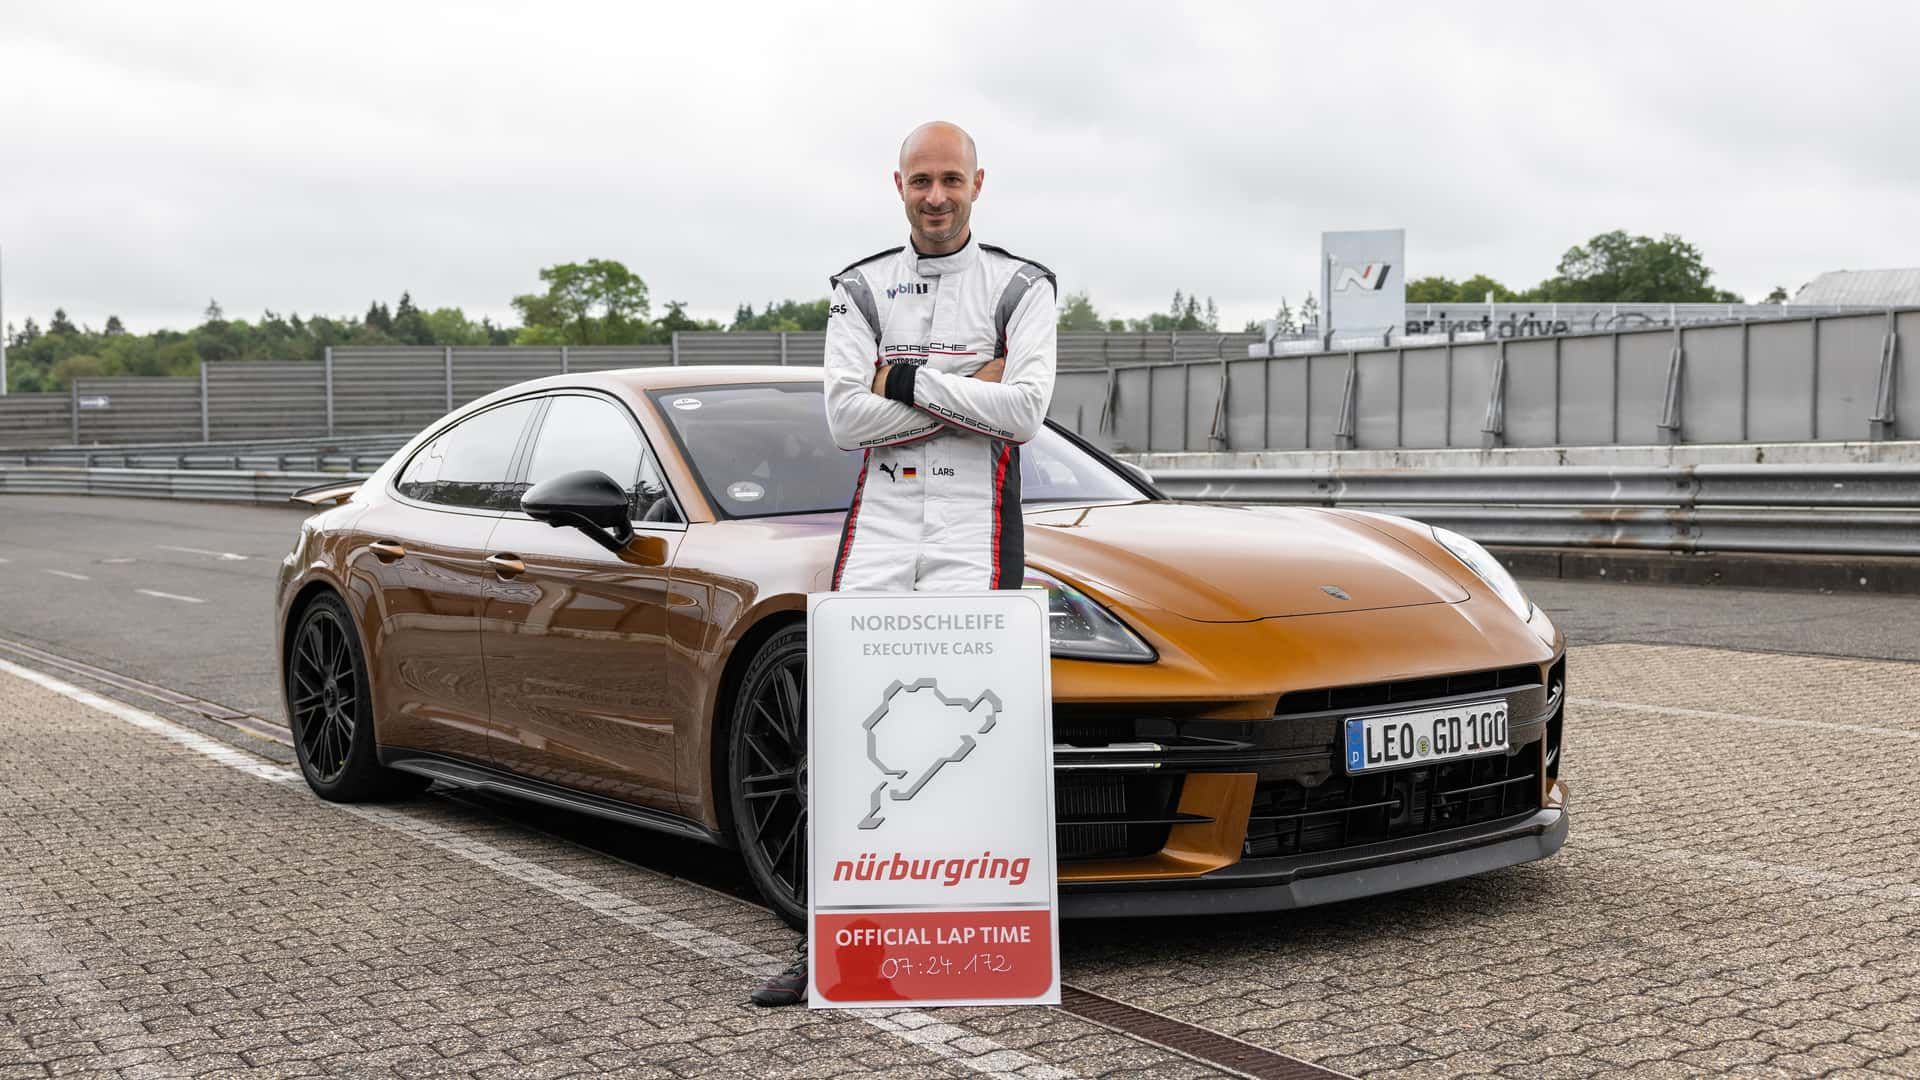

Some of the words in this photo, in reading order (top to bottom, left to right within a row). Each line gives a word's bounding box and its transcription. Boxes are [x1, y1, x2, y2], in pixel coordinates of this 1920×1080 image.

[886, 282, 914, 299] Mbil
[885, 342, 967, 353] PORSCHE
[886, 357, 929, 366] MOTORSPOR
[928, 402, 1014, 438] PORSCHE
[932, 466, 955, 477] LARS
[850, 614, 1006, 632] NORDSCHLEIFE
[863, 642, 949, 656] EXECUTIVE
[952, 641, 994, 655] CARS
[1366, 722, 1415, 764] LEO
[1352, 751, 1360, 763] D
[832, 851, 1031, 887] nürburgring
[835, 927, 931, 947] OFFICIAL
[936, 927, 976, 945] LAP
[979, 926, 1032, 944] TIME
[881, 952, 1013, 979] 07:24.172
